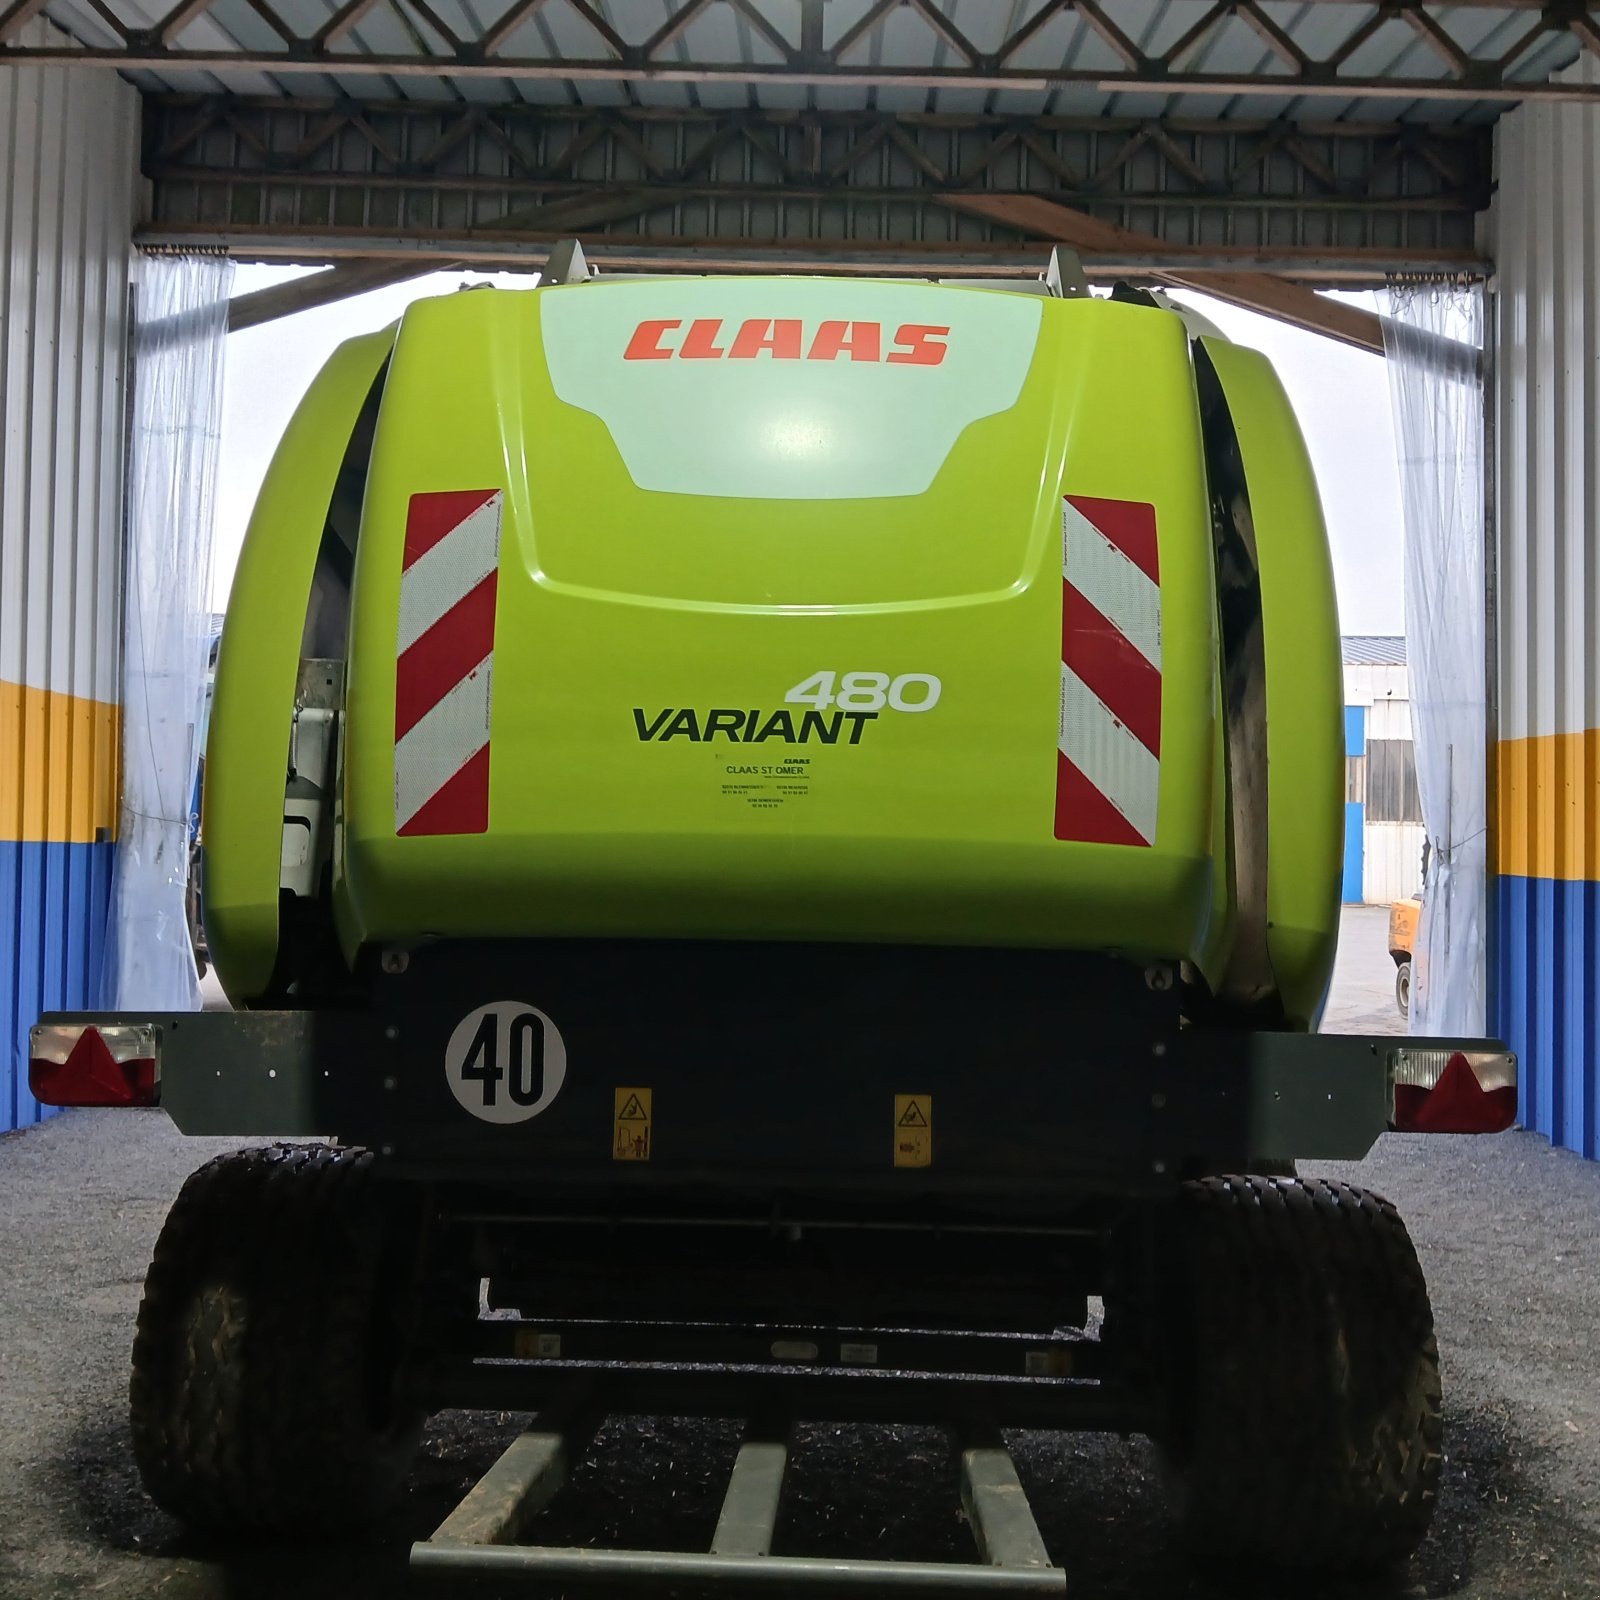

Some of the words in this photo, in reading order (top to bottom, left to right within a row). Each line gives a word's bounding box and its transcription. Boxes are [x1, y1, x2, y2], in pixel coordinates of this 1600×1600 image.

[623, 319, 951, 365] CLAAS
[784, 670, 942, 713] 480
[632, 708, 879, 745] VARIANT
[726, 765, 759, 775] CLAAS
[761, 766, 773, 775] ST
[775, 766, 804, 775] OMER
[461, 1012, 545, 1107] 40
